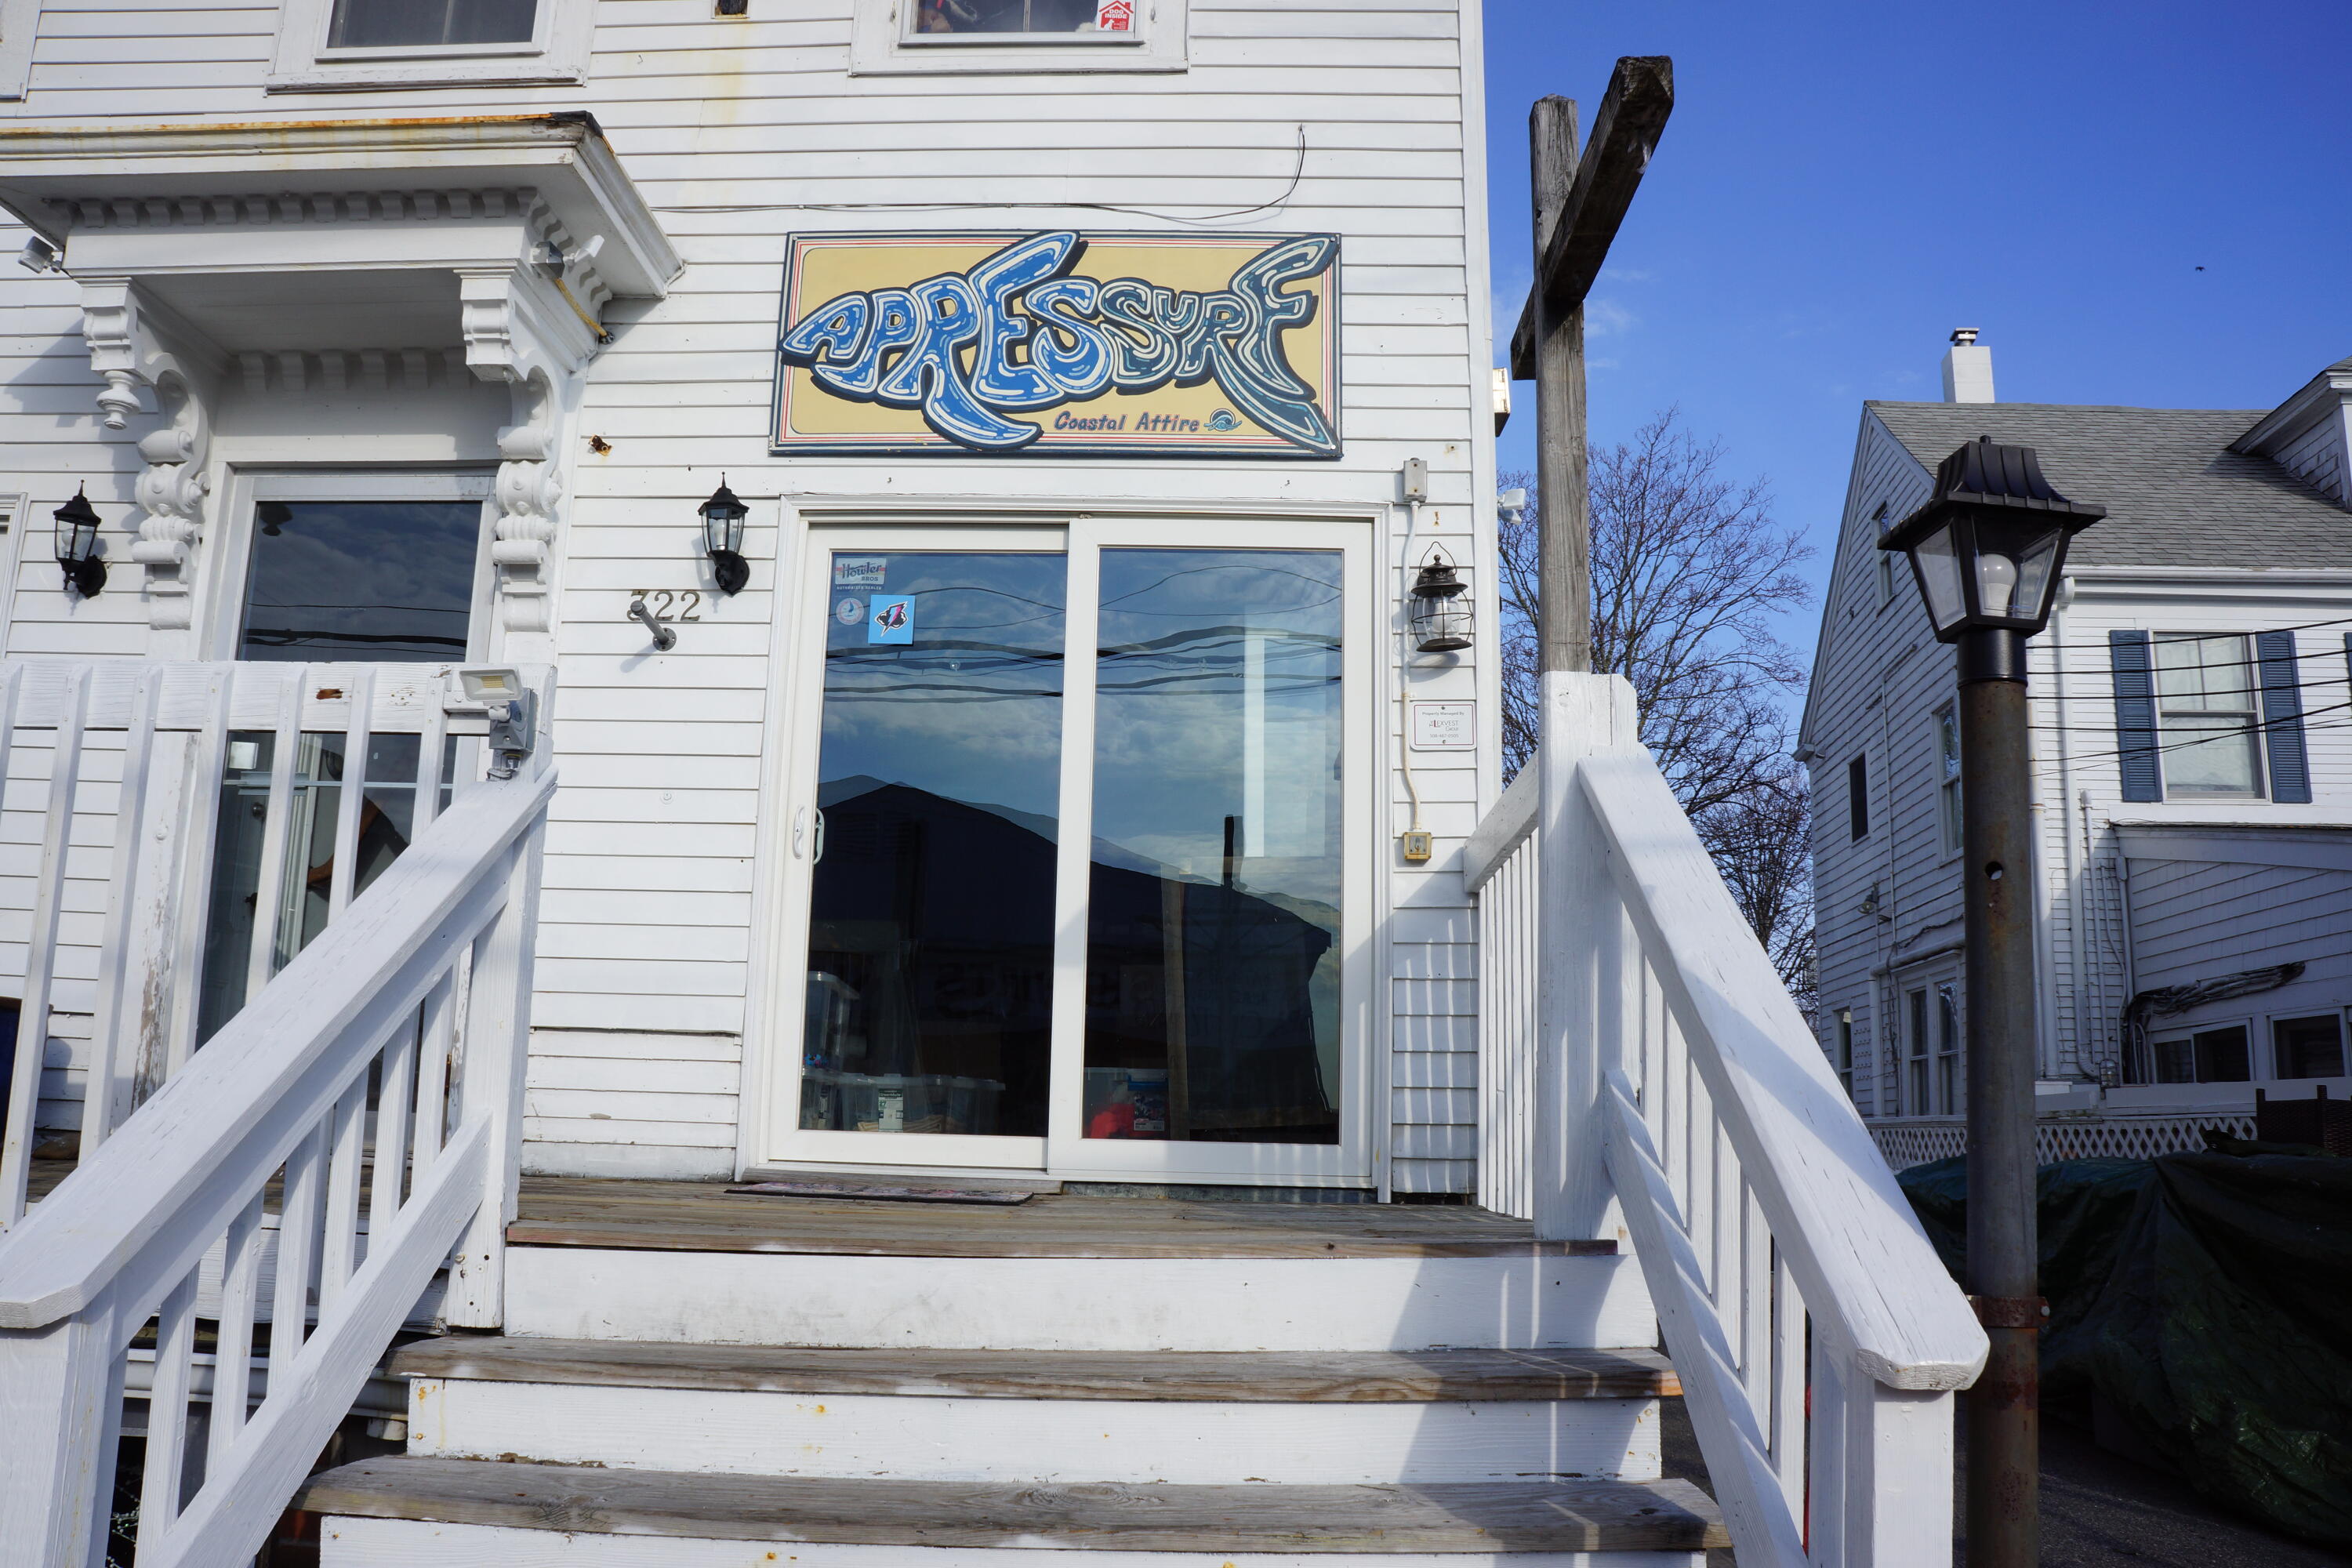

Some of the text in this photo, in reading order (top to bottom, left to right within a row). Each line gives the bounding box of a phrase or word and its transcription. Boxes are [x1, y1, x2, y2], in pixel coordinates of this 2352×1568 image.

[1054, 410, 1200, 432] Coastal Attire
[842, 561, 882, 579] Howler
